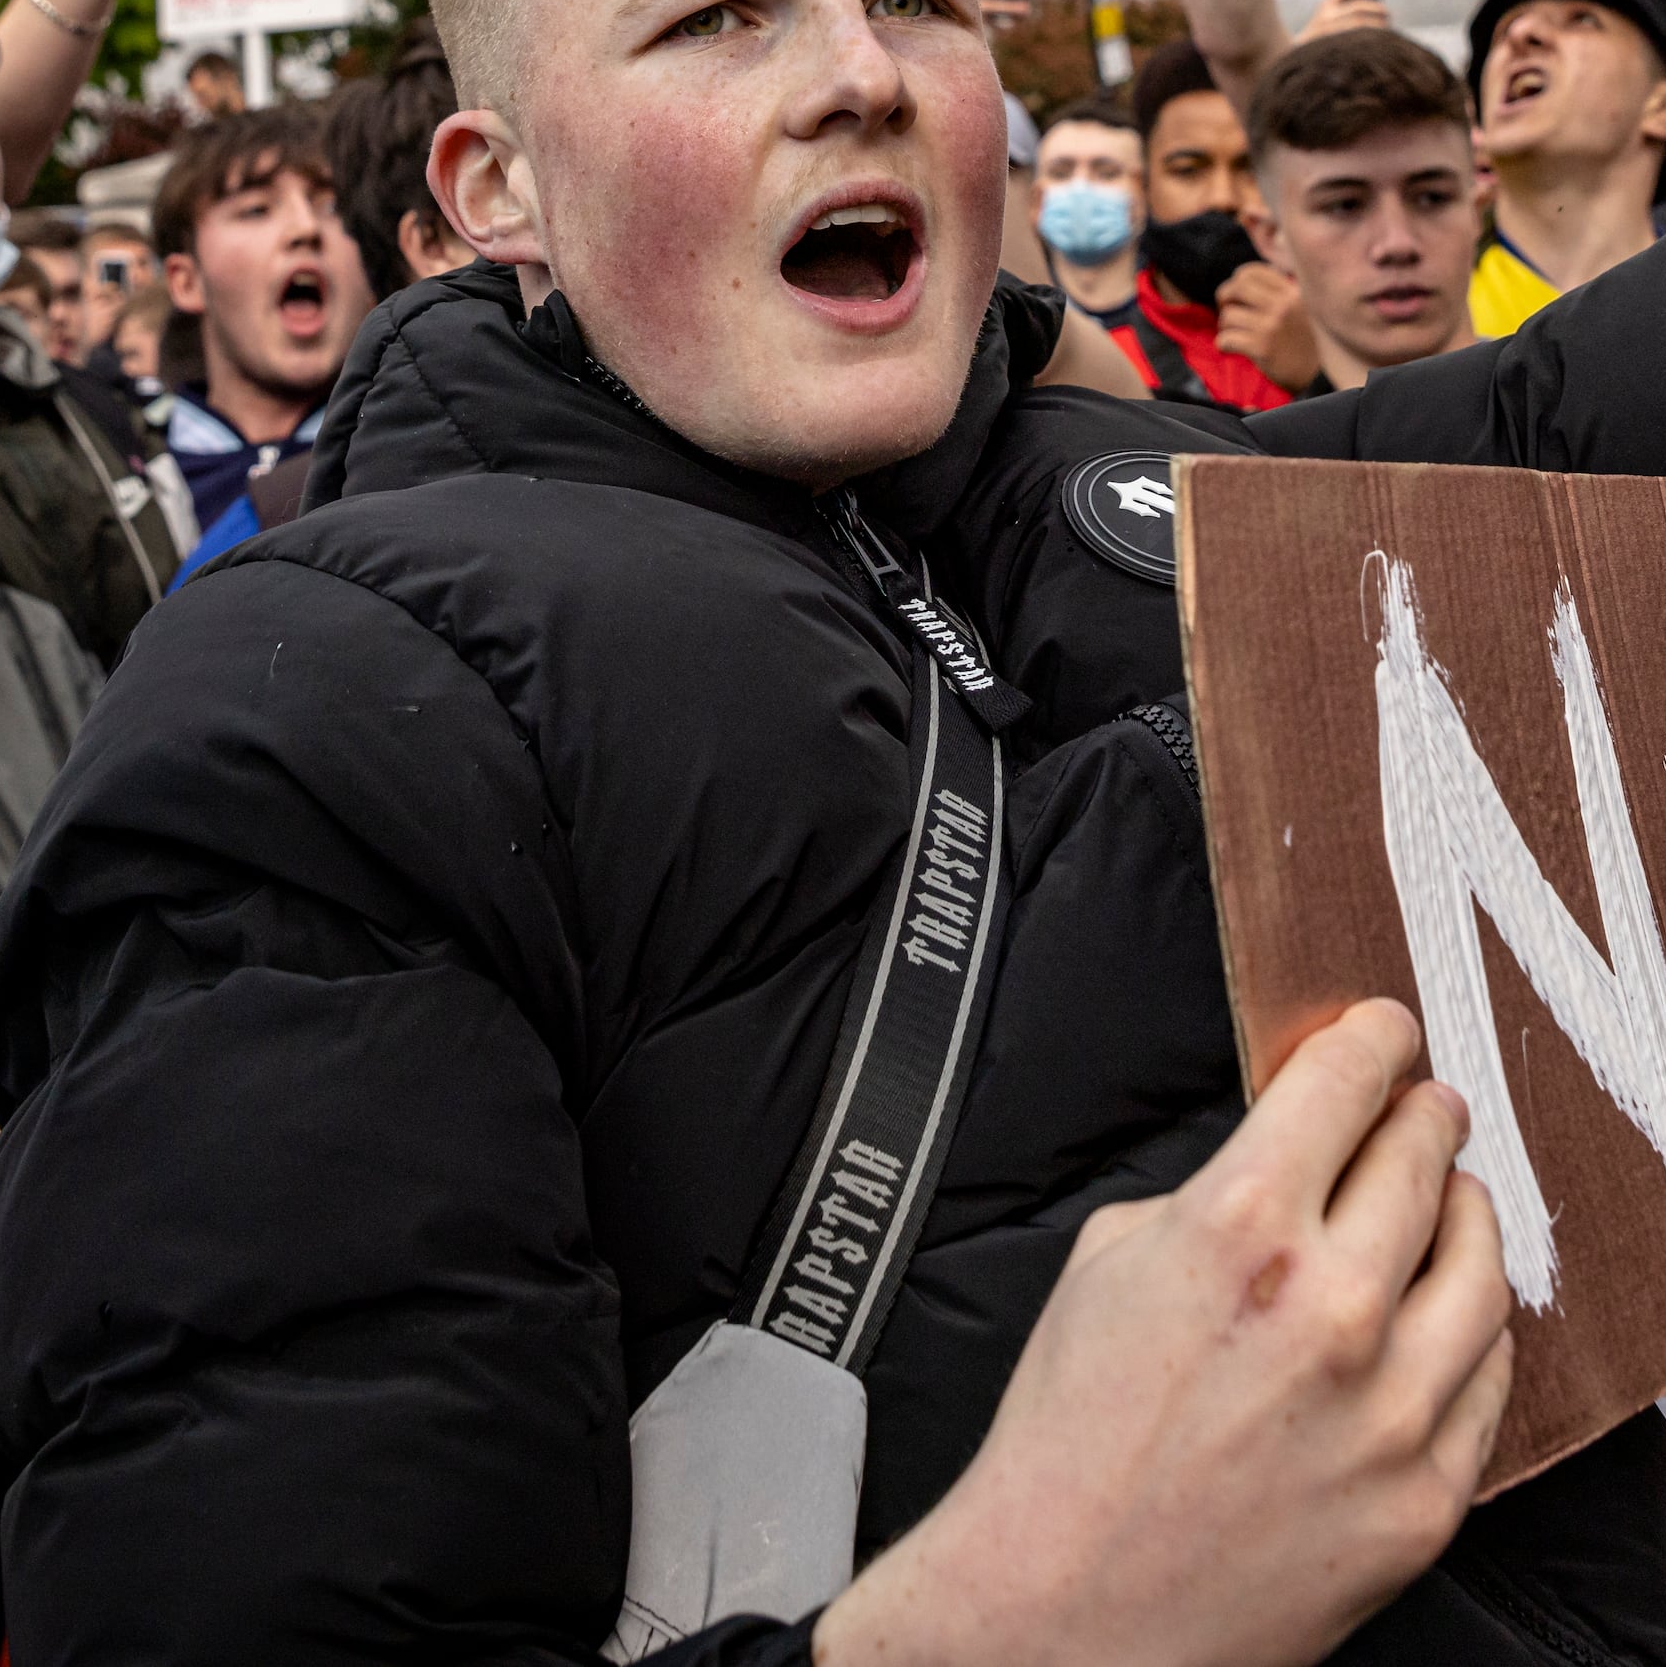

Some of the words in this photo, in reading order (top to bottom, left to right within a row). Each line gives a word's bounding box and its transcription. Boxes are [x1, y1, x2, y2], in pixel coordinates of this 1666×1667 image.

[898, 597, 996, 693] TRAPSTAR
[901, 788, 990, 974] TRAPSTAR
[768, 1138, 904, 1357] RAPSTAR
